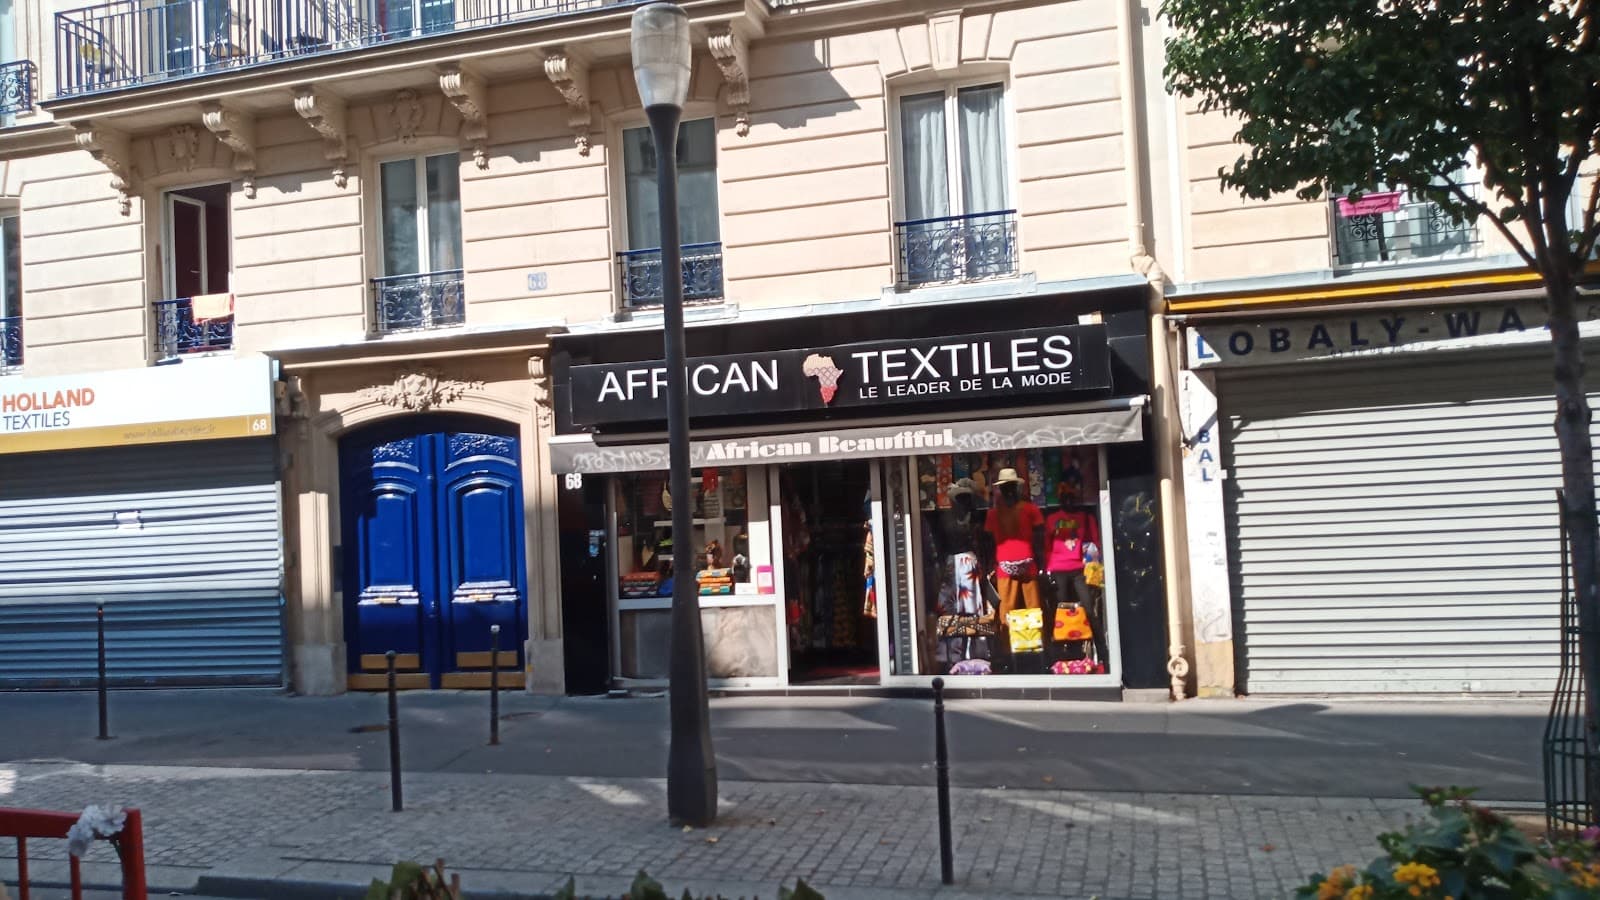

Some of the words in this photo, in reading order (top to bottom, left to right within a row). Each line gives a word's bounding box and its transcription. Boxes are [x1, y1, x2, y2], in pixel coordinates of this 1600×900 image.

[1195, 301, 1552, 361] LOBALY-WA
[851, 335, 1074, 384] TEXTILES
[859, 386, 878, 399] LE
[887, 380, 951, 397] LEADER
[960, 377, 983, 392] DE
[992, 375, 1013, 389] LA
[1021, 371, 1072, 387] MODE
[2, 387, 95, 413] HOLLAND
[3, 410, 71, 431] TEXTILES
[252, 418, 268, 431] 68
[705, 441, 812, 461] African
[818, 428, 953, 454] Beautiful
[565, 472, 583, 490] 68
